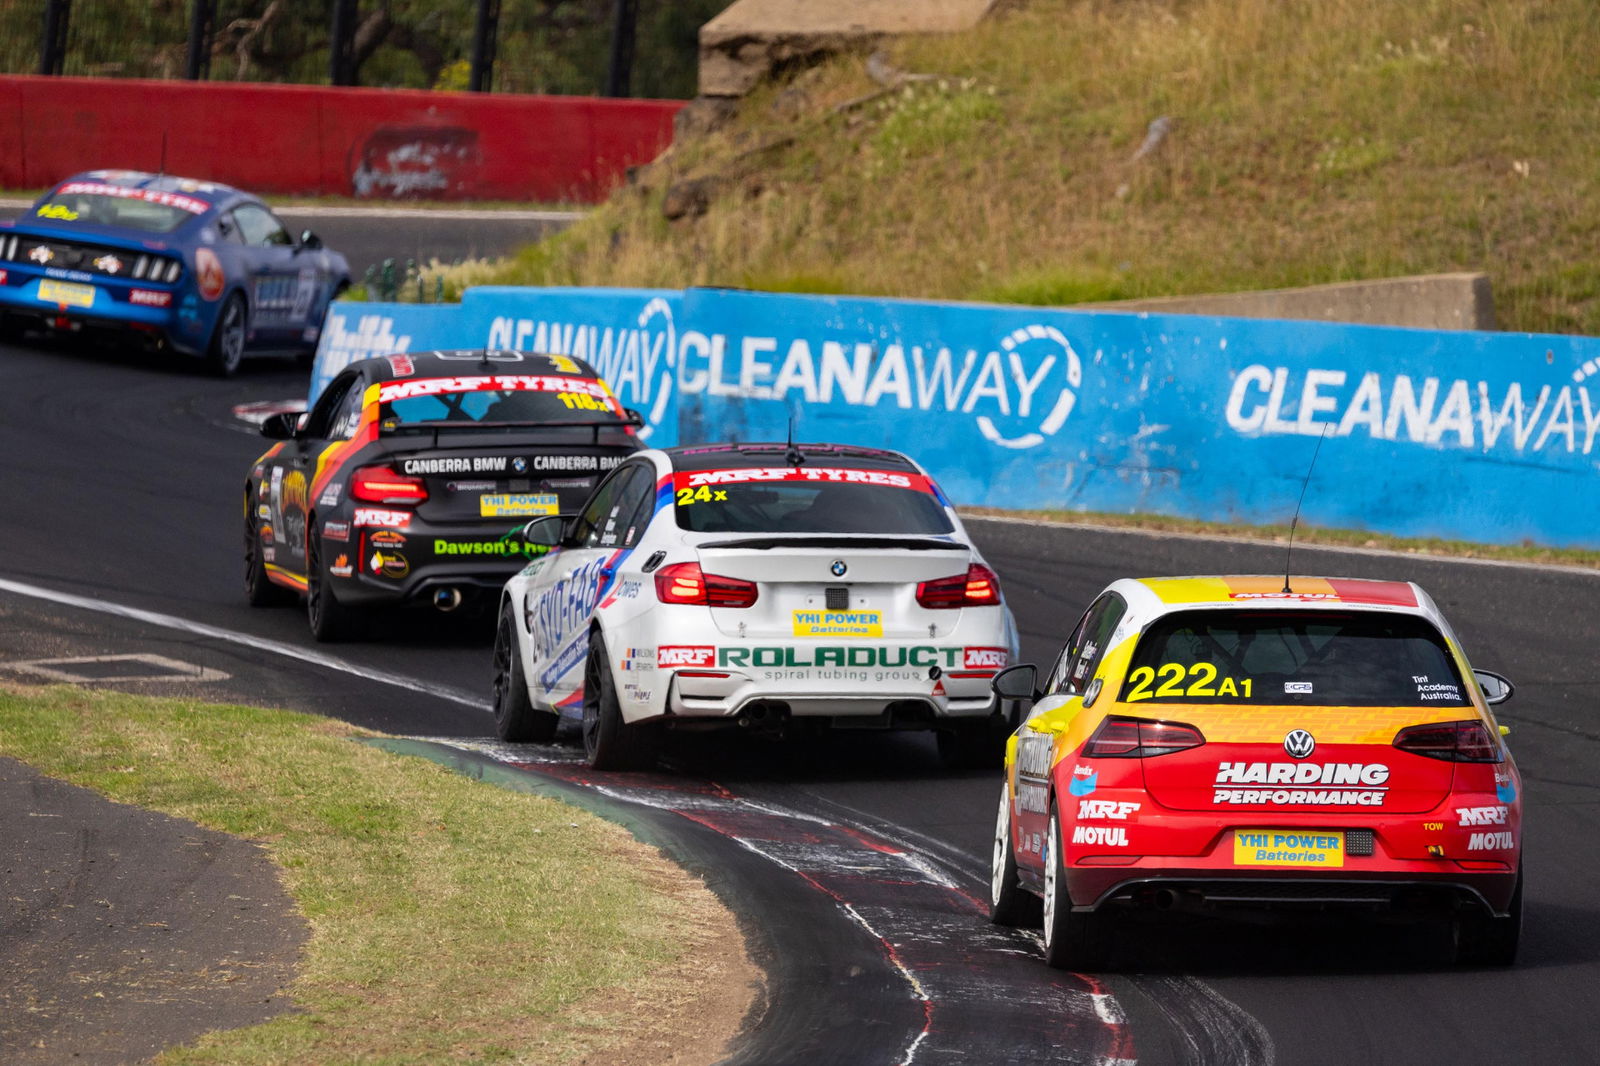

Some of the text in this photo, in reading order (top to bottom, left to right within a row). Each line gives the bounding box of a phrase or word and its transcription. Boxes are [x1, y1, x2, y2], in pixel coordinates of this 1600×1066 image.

[678, 330, 1056, 417] CLEANAWAY
[379, 376, 608, 402] MRF TYRES
[405, 457, 507, 474] CANBERRA BMW
[534, 456, 597, 471] CANBERRA
[689, 468, 911, 487] MRF TYRES
[509, 495, 557, 506] POWER
[354, 509, 411, 526] MRF
[434, 538, 519, 555] Dawson's
[796, 613, 879, 625] YHI POWER
[659, 648, 714, 665] MRF
[718, 645, 963, 667] ROLADUCT
[764, 669, 813, 682] spiral
[818, 669, 870, 682] tubing
[1412, 675, 1429, 684] Tint
[1417, 684, 1458, 693] Academy
[1215, 762, 1389, 785] HARDING
[1213, 790, 1385, 806] PERFORMANCE
[1077, 800, 1141, 820] MRF
[1455, 806, 1508, 826] MRF
[1072, 826, 1129, 846] MOTUL
[1423, 823, 1444, 832] TOW
[1238, 834, 1340, 850] YHI POWER
[1467, 832, 1514, 851] MOTUL
[1255, 849, 1326, 863] Batteries
